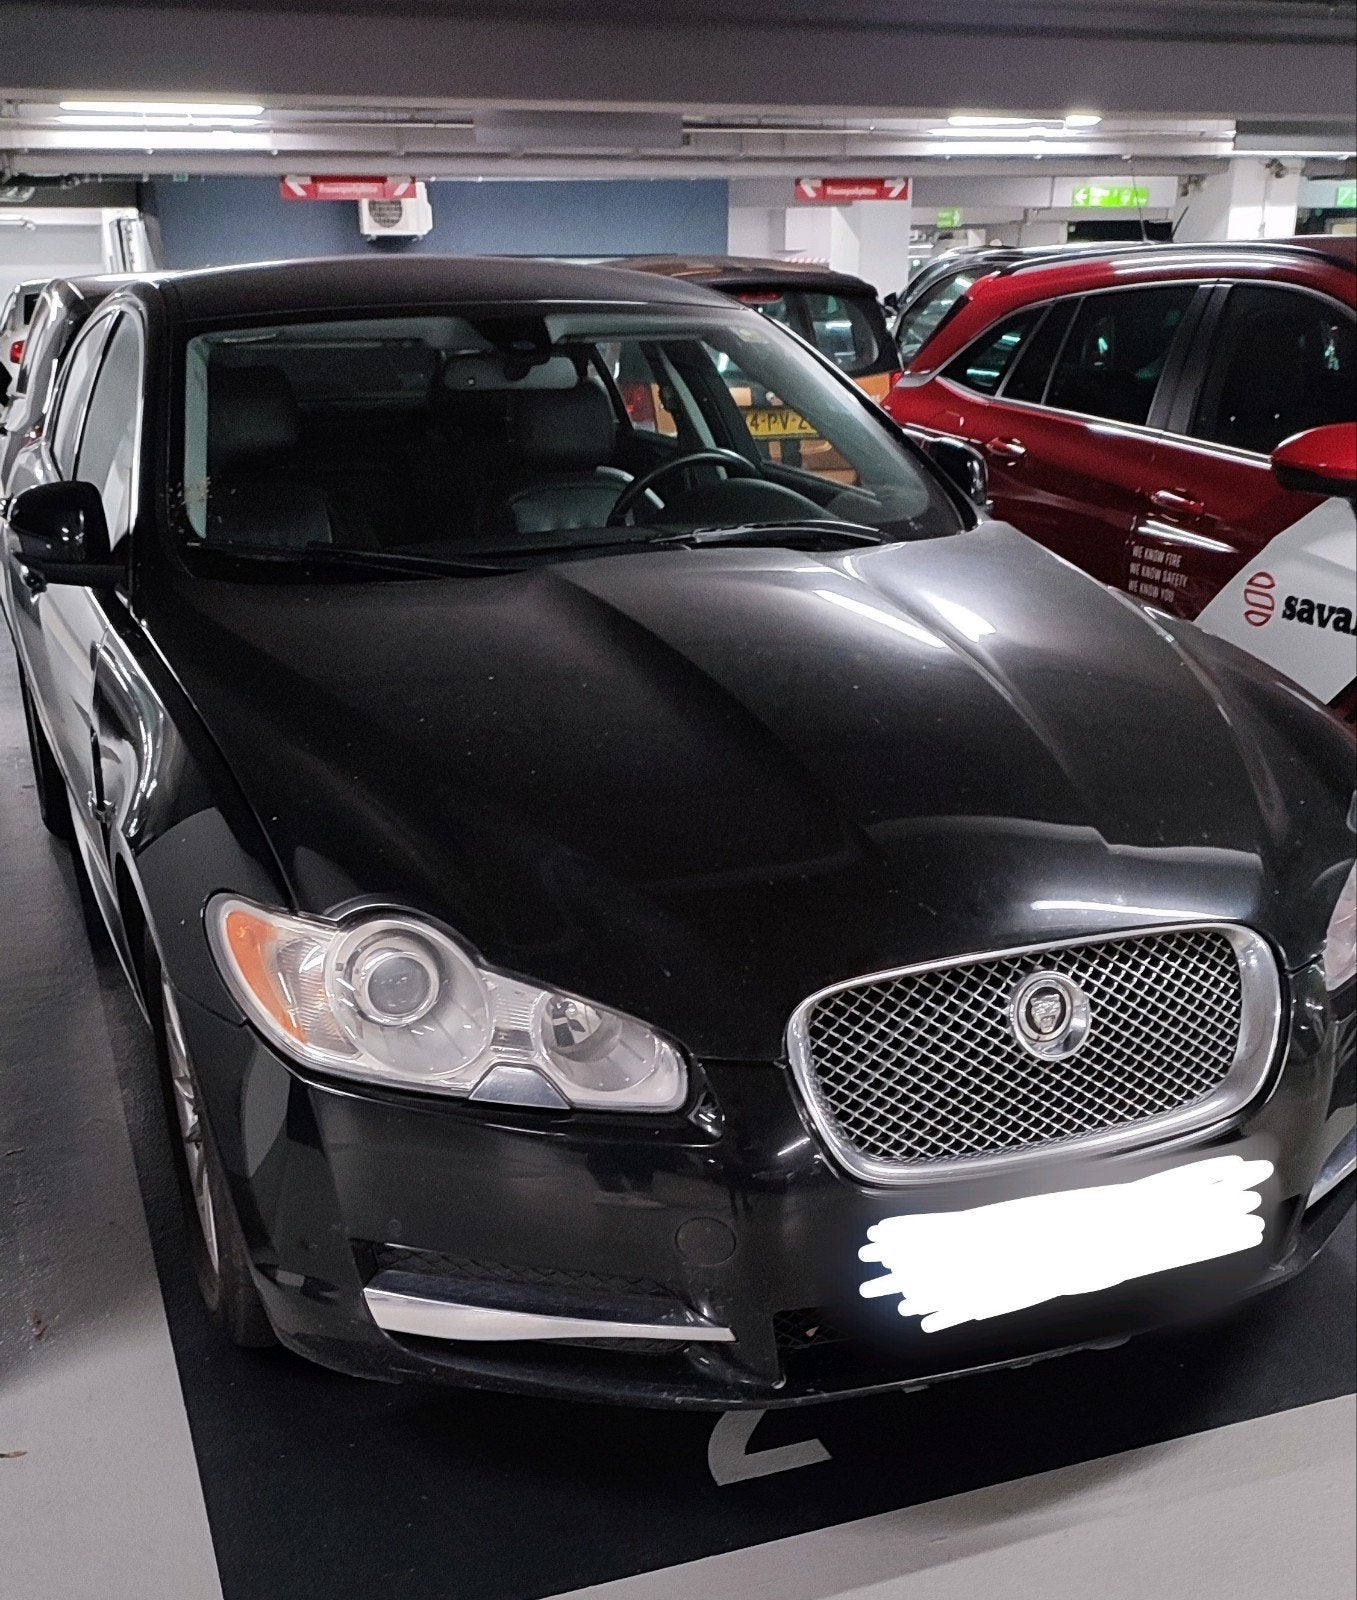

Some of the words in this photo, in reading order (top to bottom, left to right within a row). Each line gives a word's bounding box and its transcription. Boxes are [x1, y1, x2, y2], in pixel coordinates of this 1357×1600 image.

[1132, 545, 1144, 558] WE
[1144, 547, 1165, 563] KNOW
[1165, 552, 1182, 568] FIRE
[1129, 562, 1140, 576] WE
[1141, 565, 1161, 580] KNOW
[1162, 569, 1188, 588] SAFETY
[1128, 580, 1138, 592] WE
[1140, 582, 1160, 598] KNOW
[1160, 587, 1175, 603] YOU
